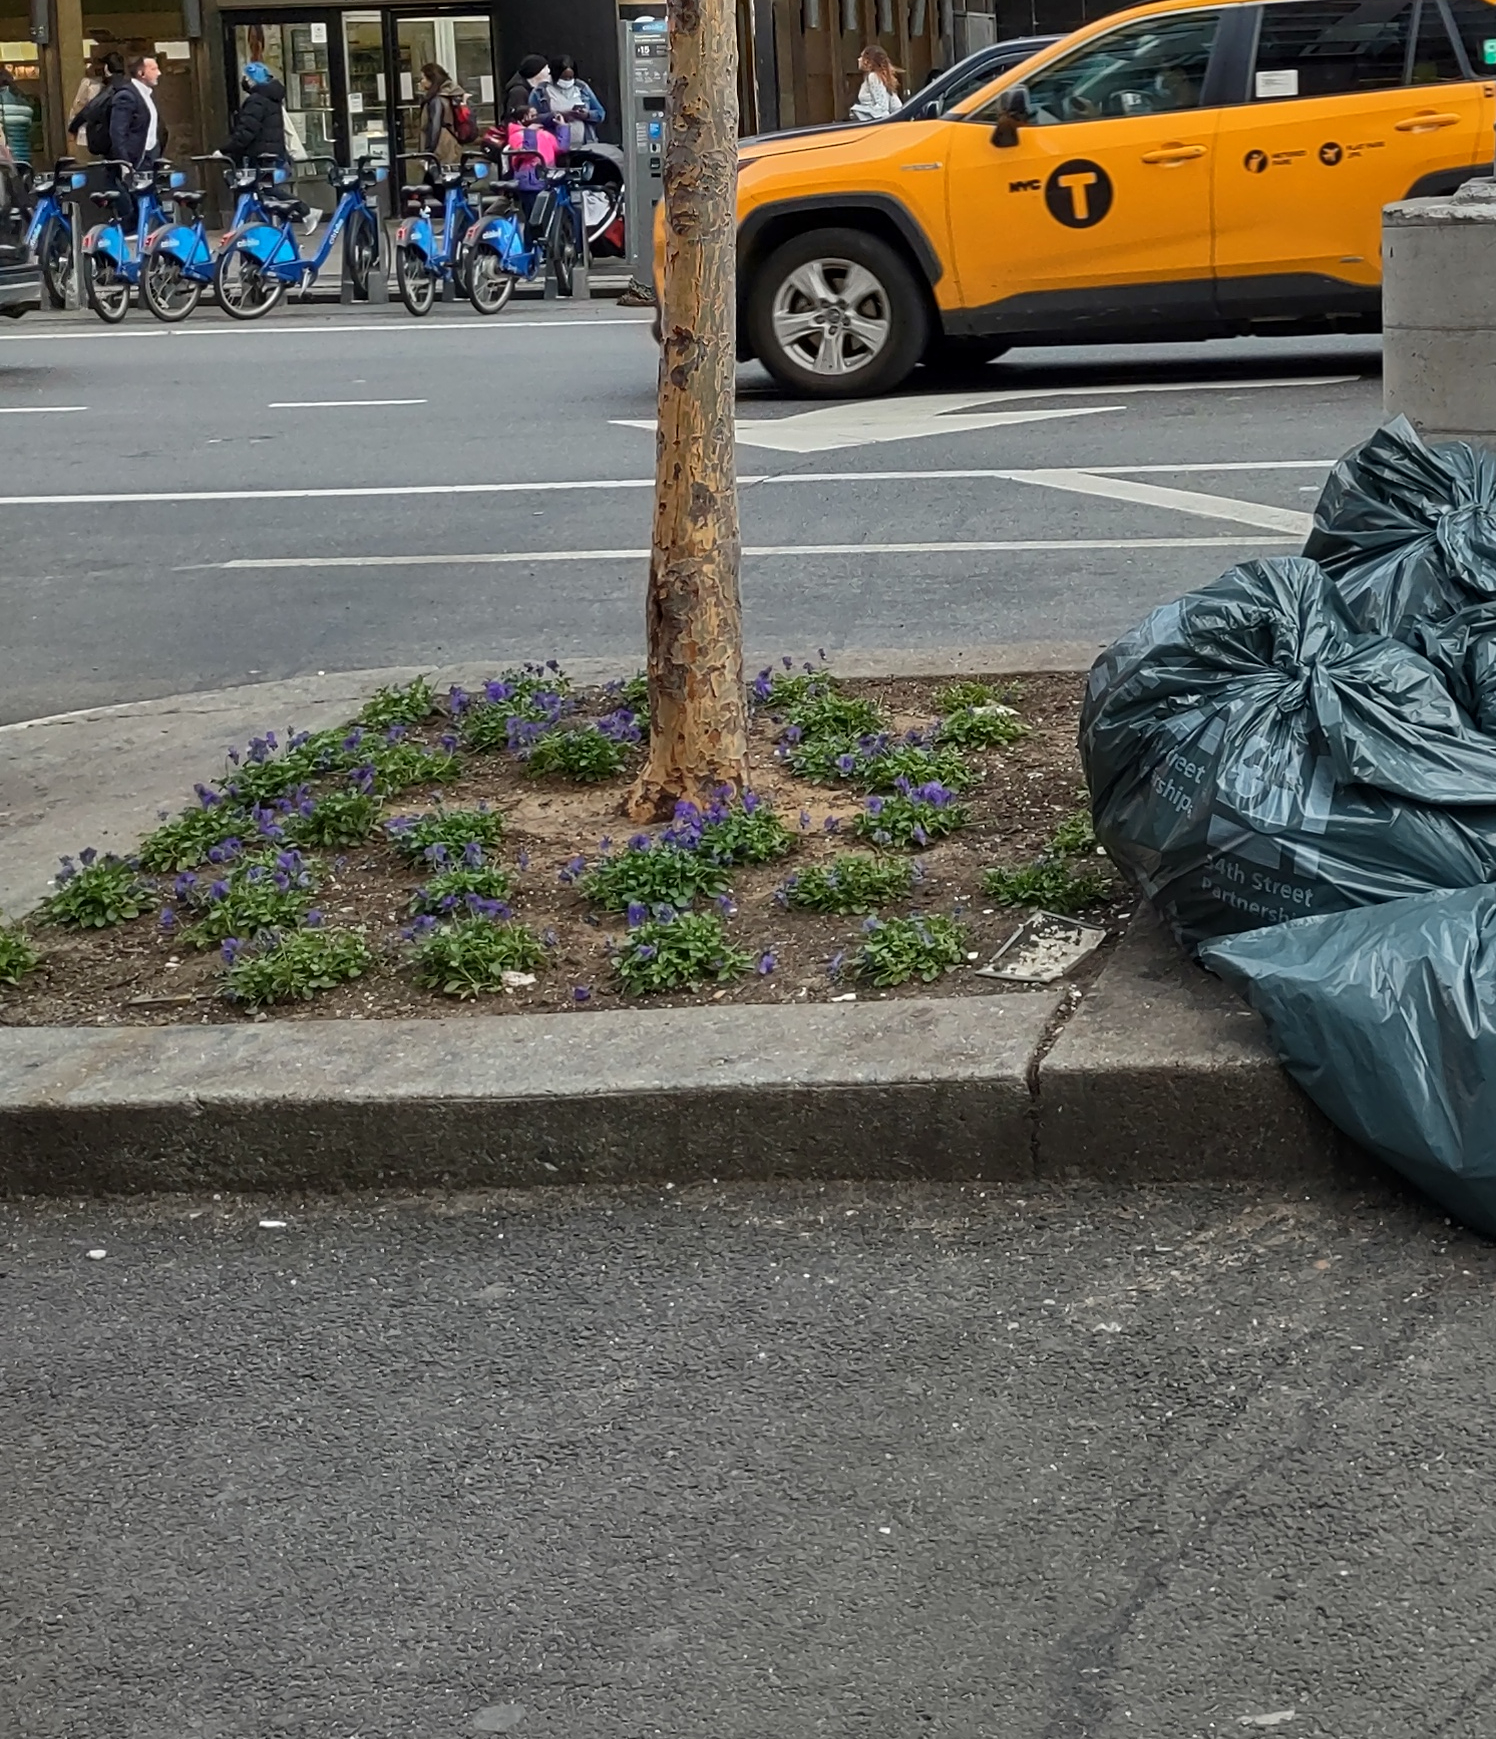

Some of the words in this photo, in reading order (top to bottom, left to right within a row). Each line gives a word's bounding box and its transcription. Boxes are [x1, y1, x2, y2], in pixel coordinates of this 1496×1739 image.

[1008, 178, 1042, 193] NYC
[1058, 171, 1098, 220] T
[1252, 871, 1315, 908] Street
